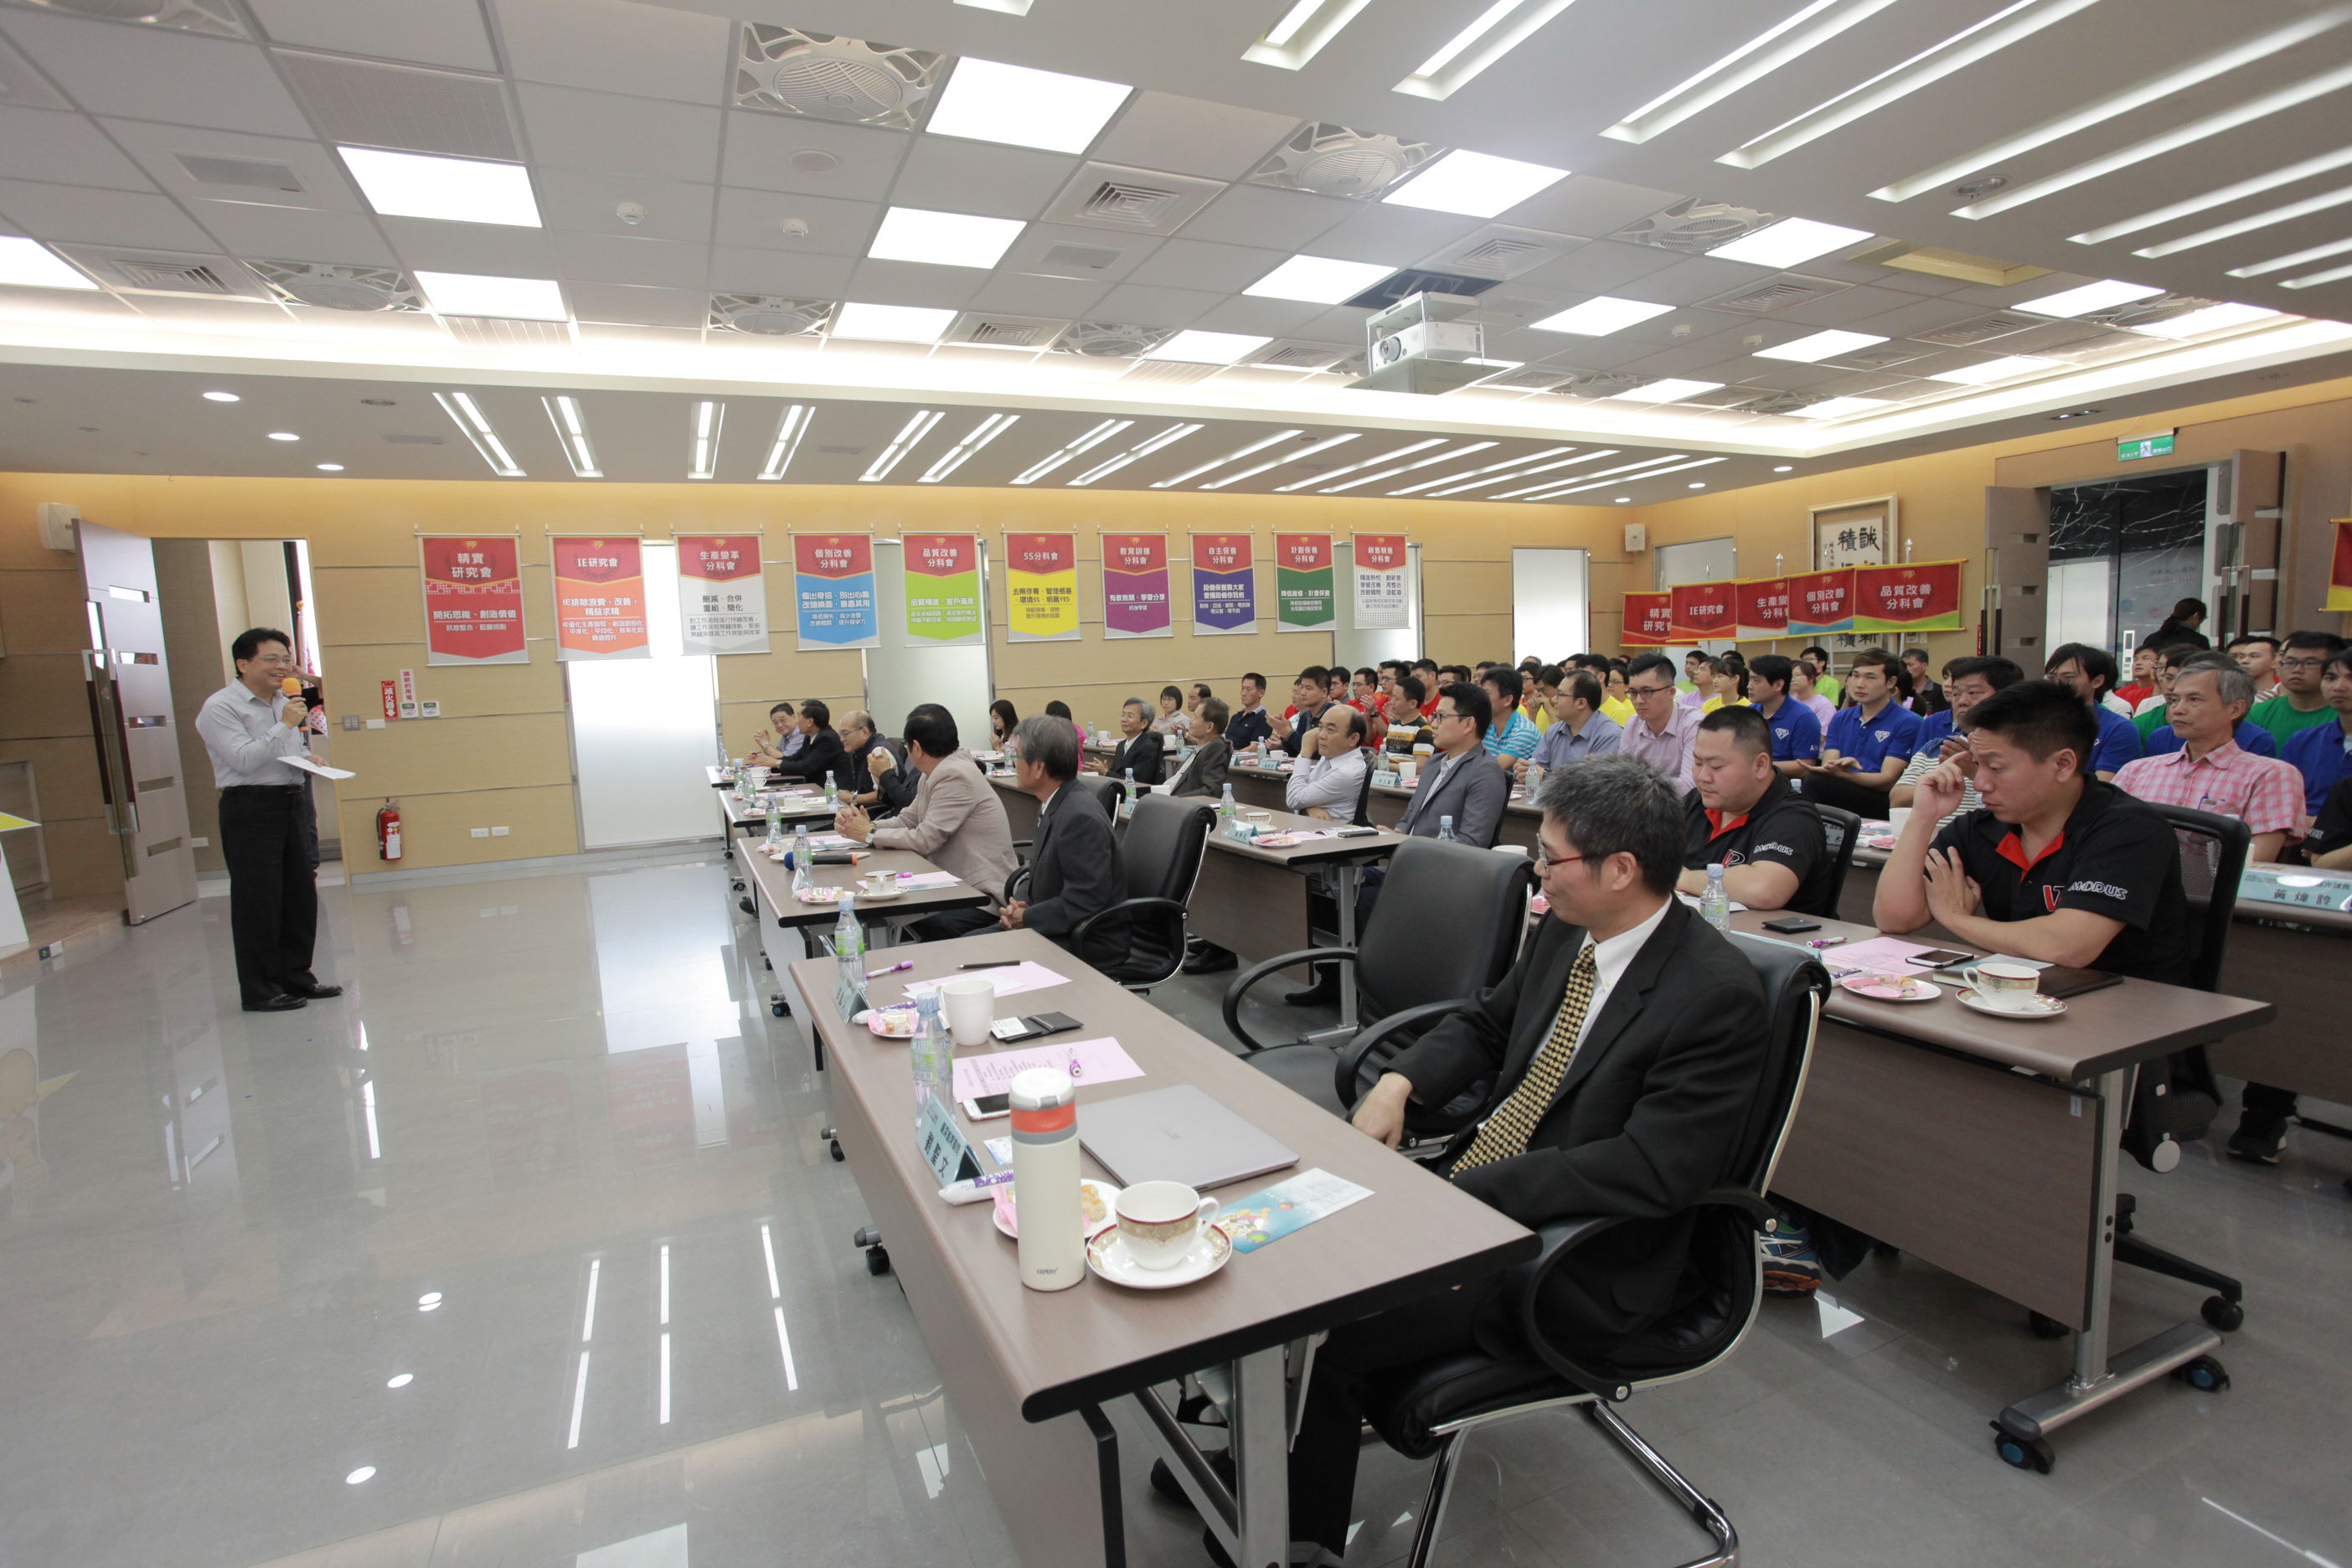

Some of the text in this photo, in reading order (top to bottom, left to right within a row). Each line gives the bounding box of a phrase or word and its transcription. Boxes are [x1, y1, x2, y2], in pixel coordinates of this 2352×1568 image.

[699, 551, 740, 560] 生產變革
[815, 549, 852, 558] 個別改善
[922, 549, 957, 557] 品質改善
[1119, 547, 1151, 555] 教育訓練
[456, 553, 484, 564] 精實
[1024, 552, 1058, 560] 5S分科會
[1124, 556, 1147, 565] 分科會
[577, 558, 617, 567] IE研究會
[705, 562, 735, 570] 分科會
[820, 560, 848, 569] 分科會
[927, 559, 953, 567] 分科會
[451, 567, 492, 578] 研究會
[1806, 588, 1844, 601] 個別改善
[1880, 584, 1932, 596] 品質改善
[1812, 601, 1839, 614] 分科會
[1886, 598, 1924, 610] 分科會
[1689, 605, 1724, 616] IE研究會
[2067, 880, 2128, 900] MODUS
